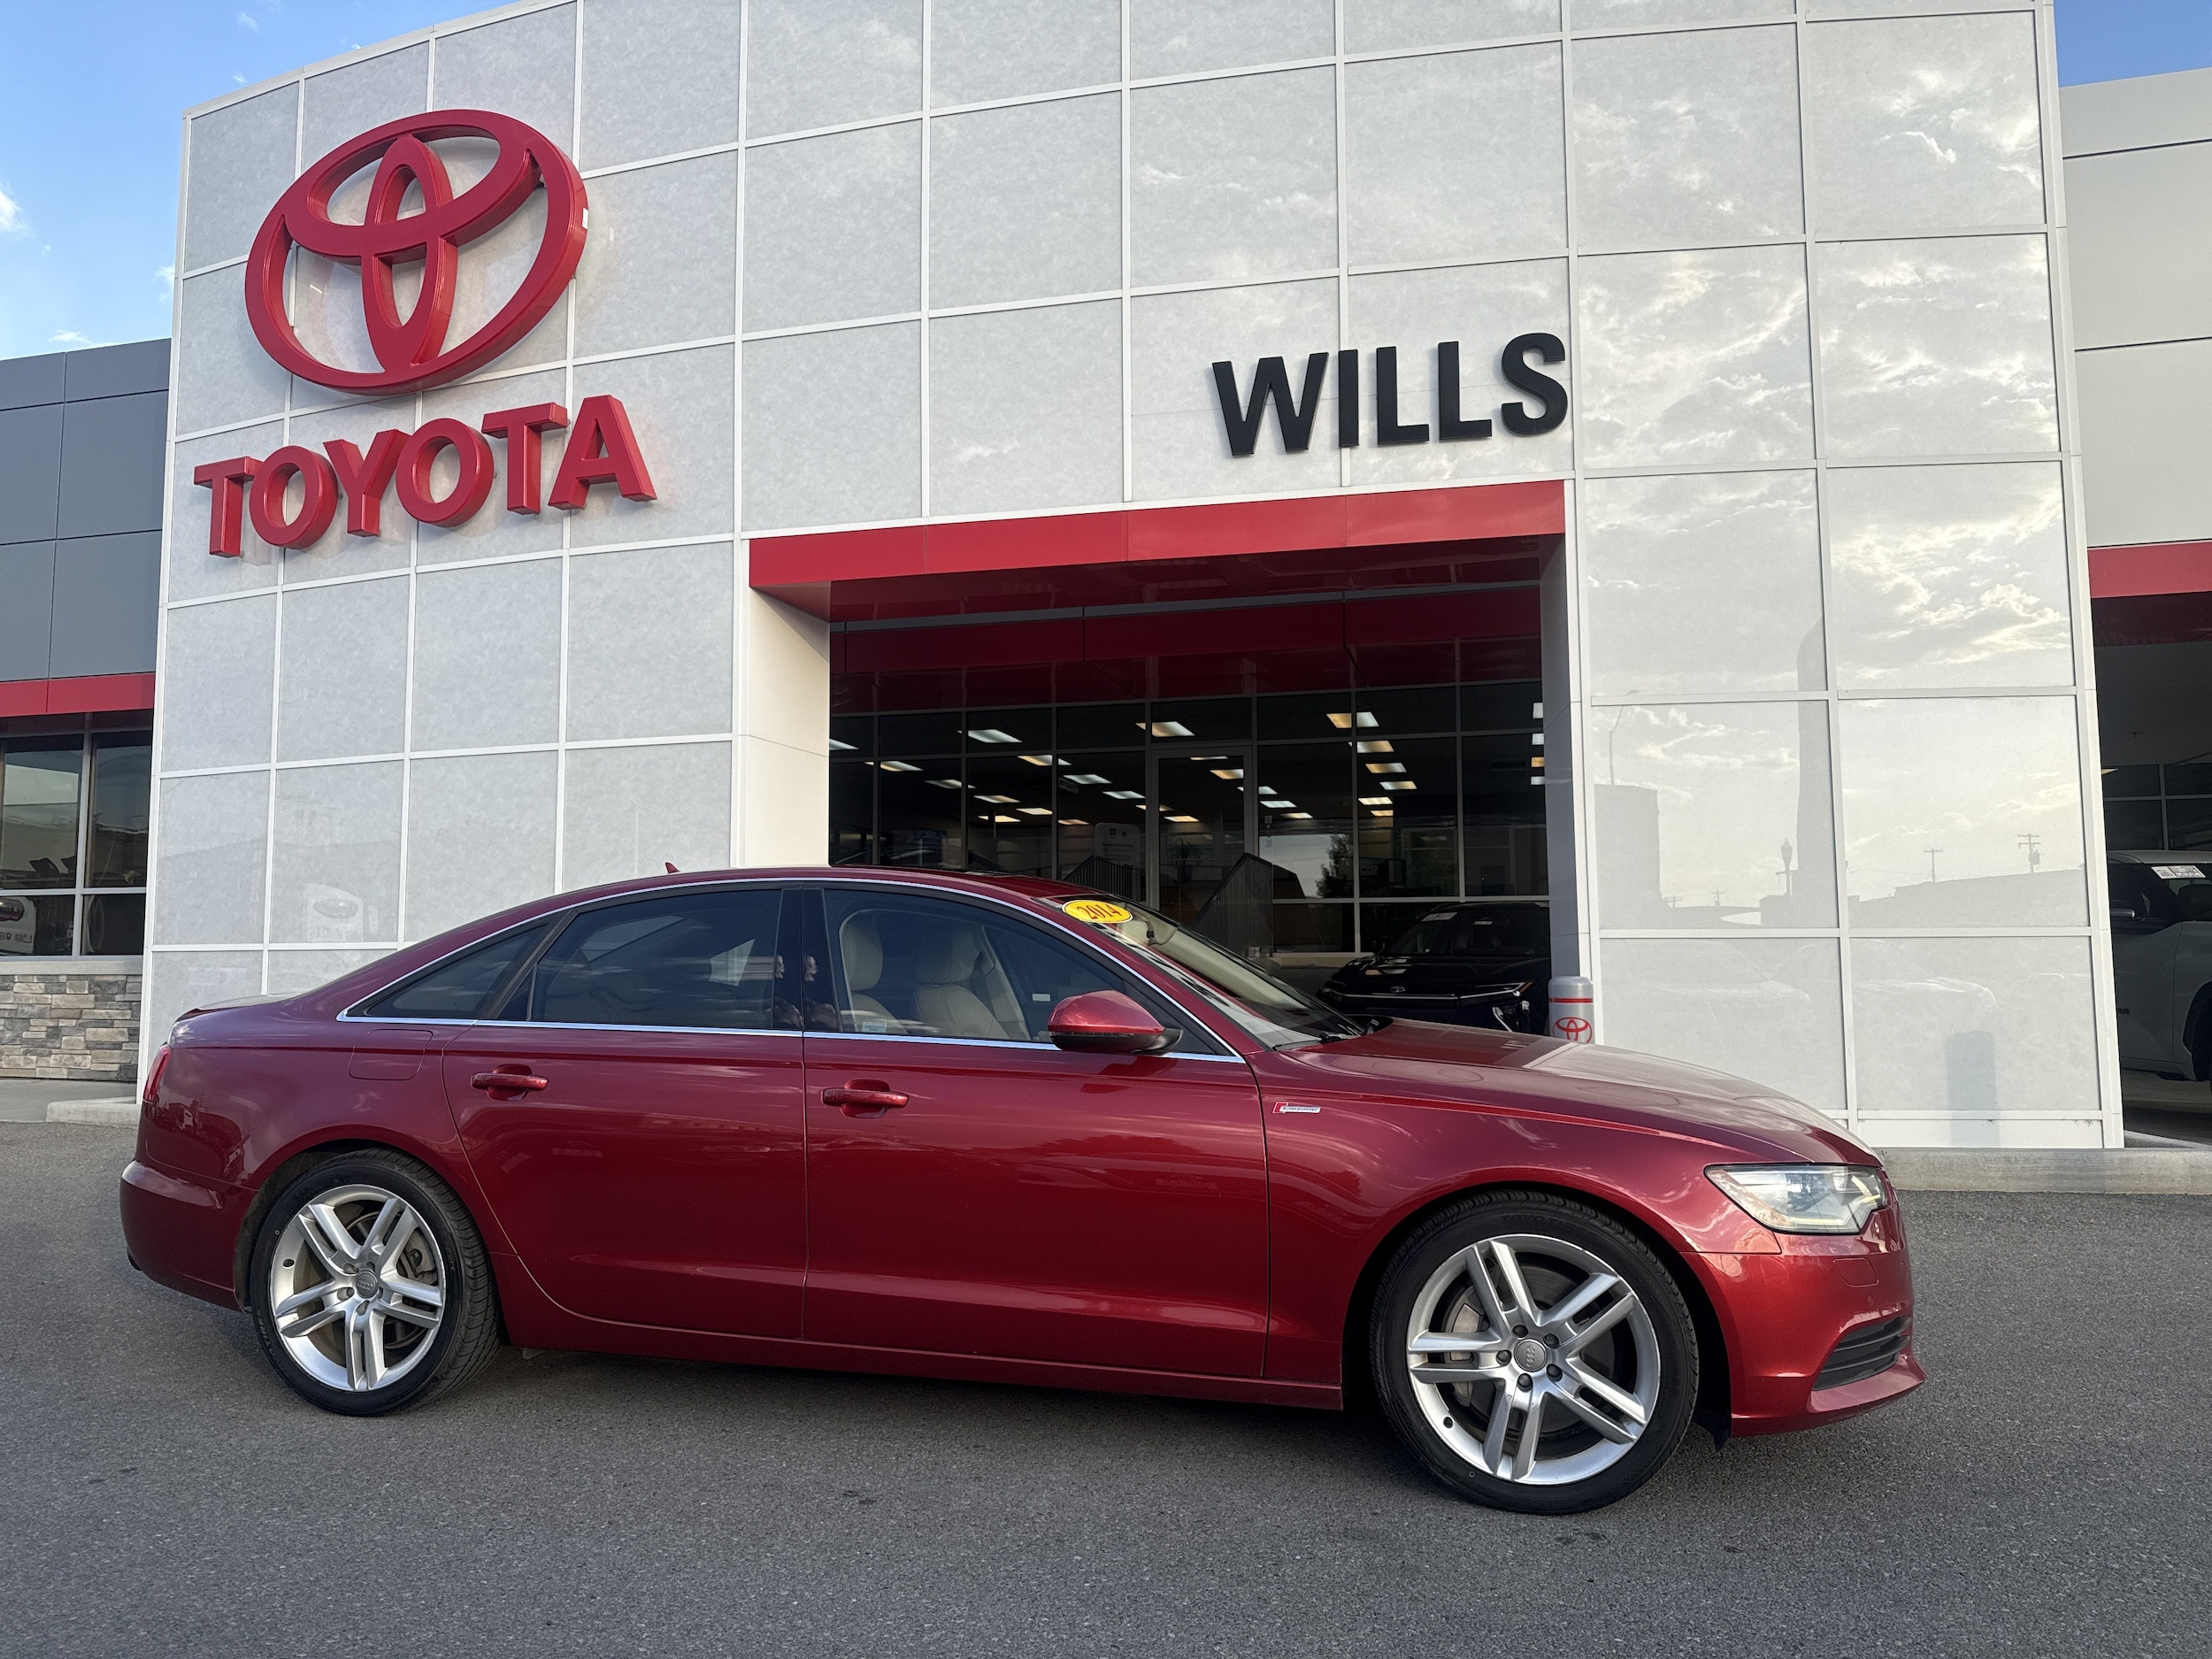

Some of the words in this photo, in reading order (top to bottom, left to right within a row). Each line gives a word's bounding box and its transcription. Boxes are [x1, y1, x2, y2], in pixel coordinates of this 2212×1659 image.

[1211, 332, 1569, 457] WILLS
[193, 394, 657, 558] TOYOTA
[1076, 903, 1123, 920] 2014
